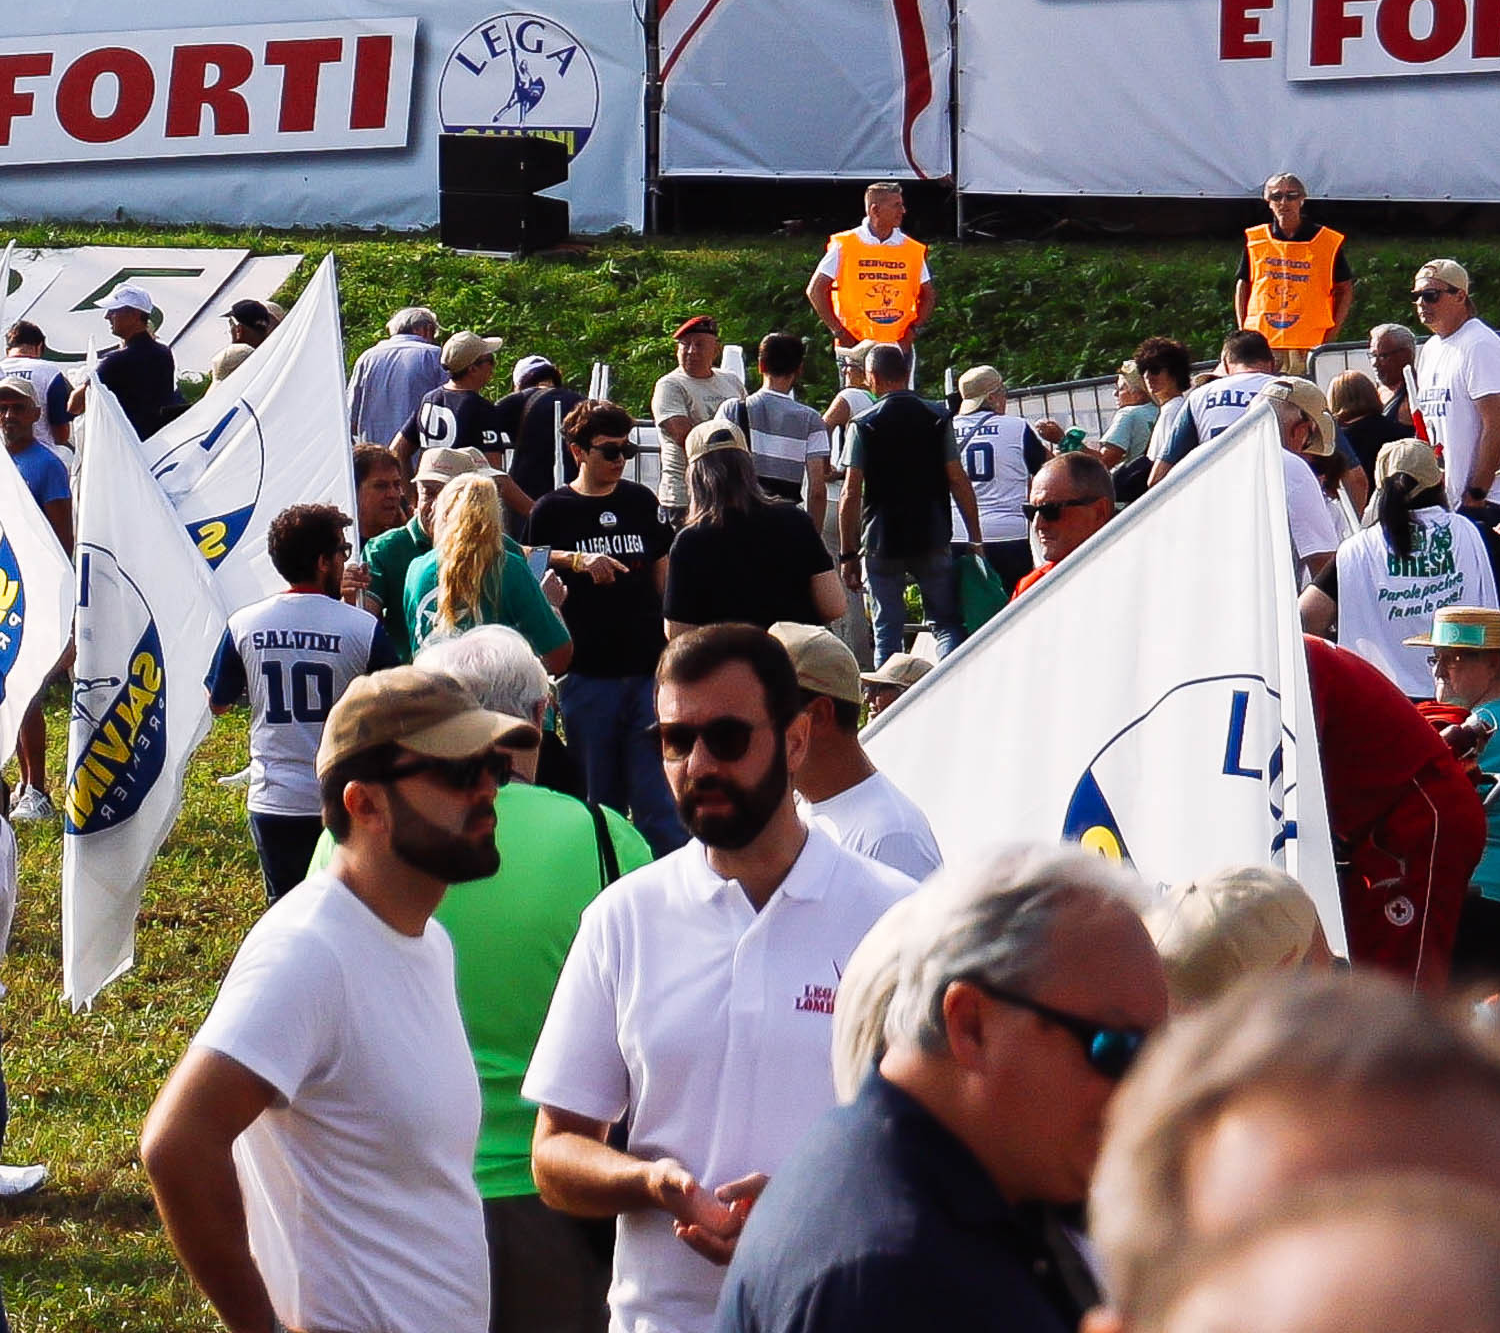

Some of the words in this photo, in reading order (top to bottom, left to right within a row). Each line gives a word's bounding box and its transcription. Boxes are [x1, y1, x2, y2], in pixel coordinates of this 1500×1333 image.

[454, 19, 578, 78] LEGA
[612, 536, 623, 554] CI
[624, 535, 645, 554] LEGA
[252, 632, 342, 654] SALVINI
[261, 661, 335, 725] 10
